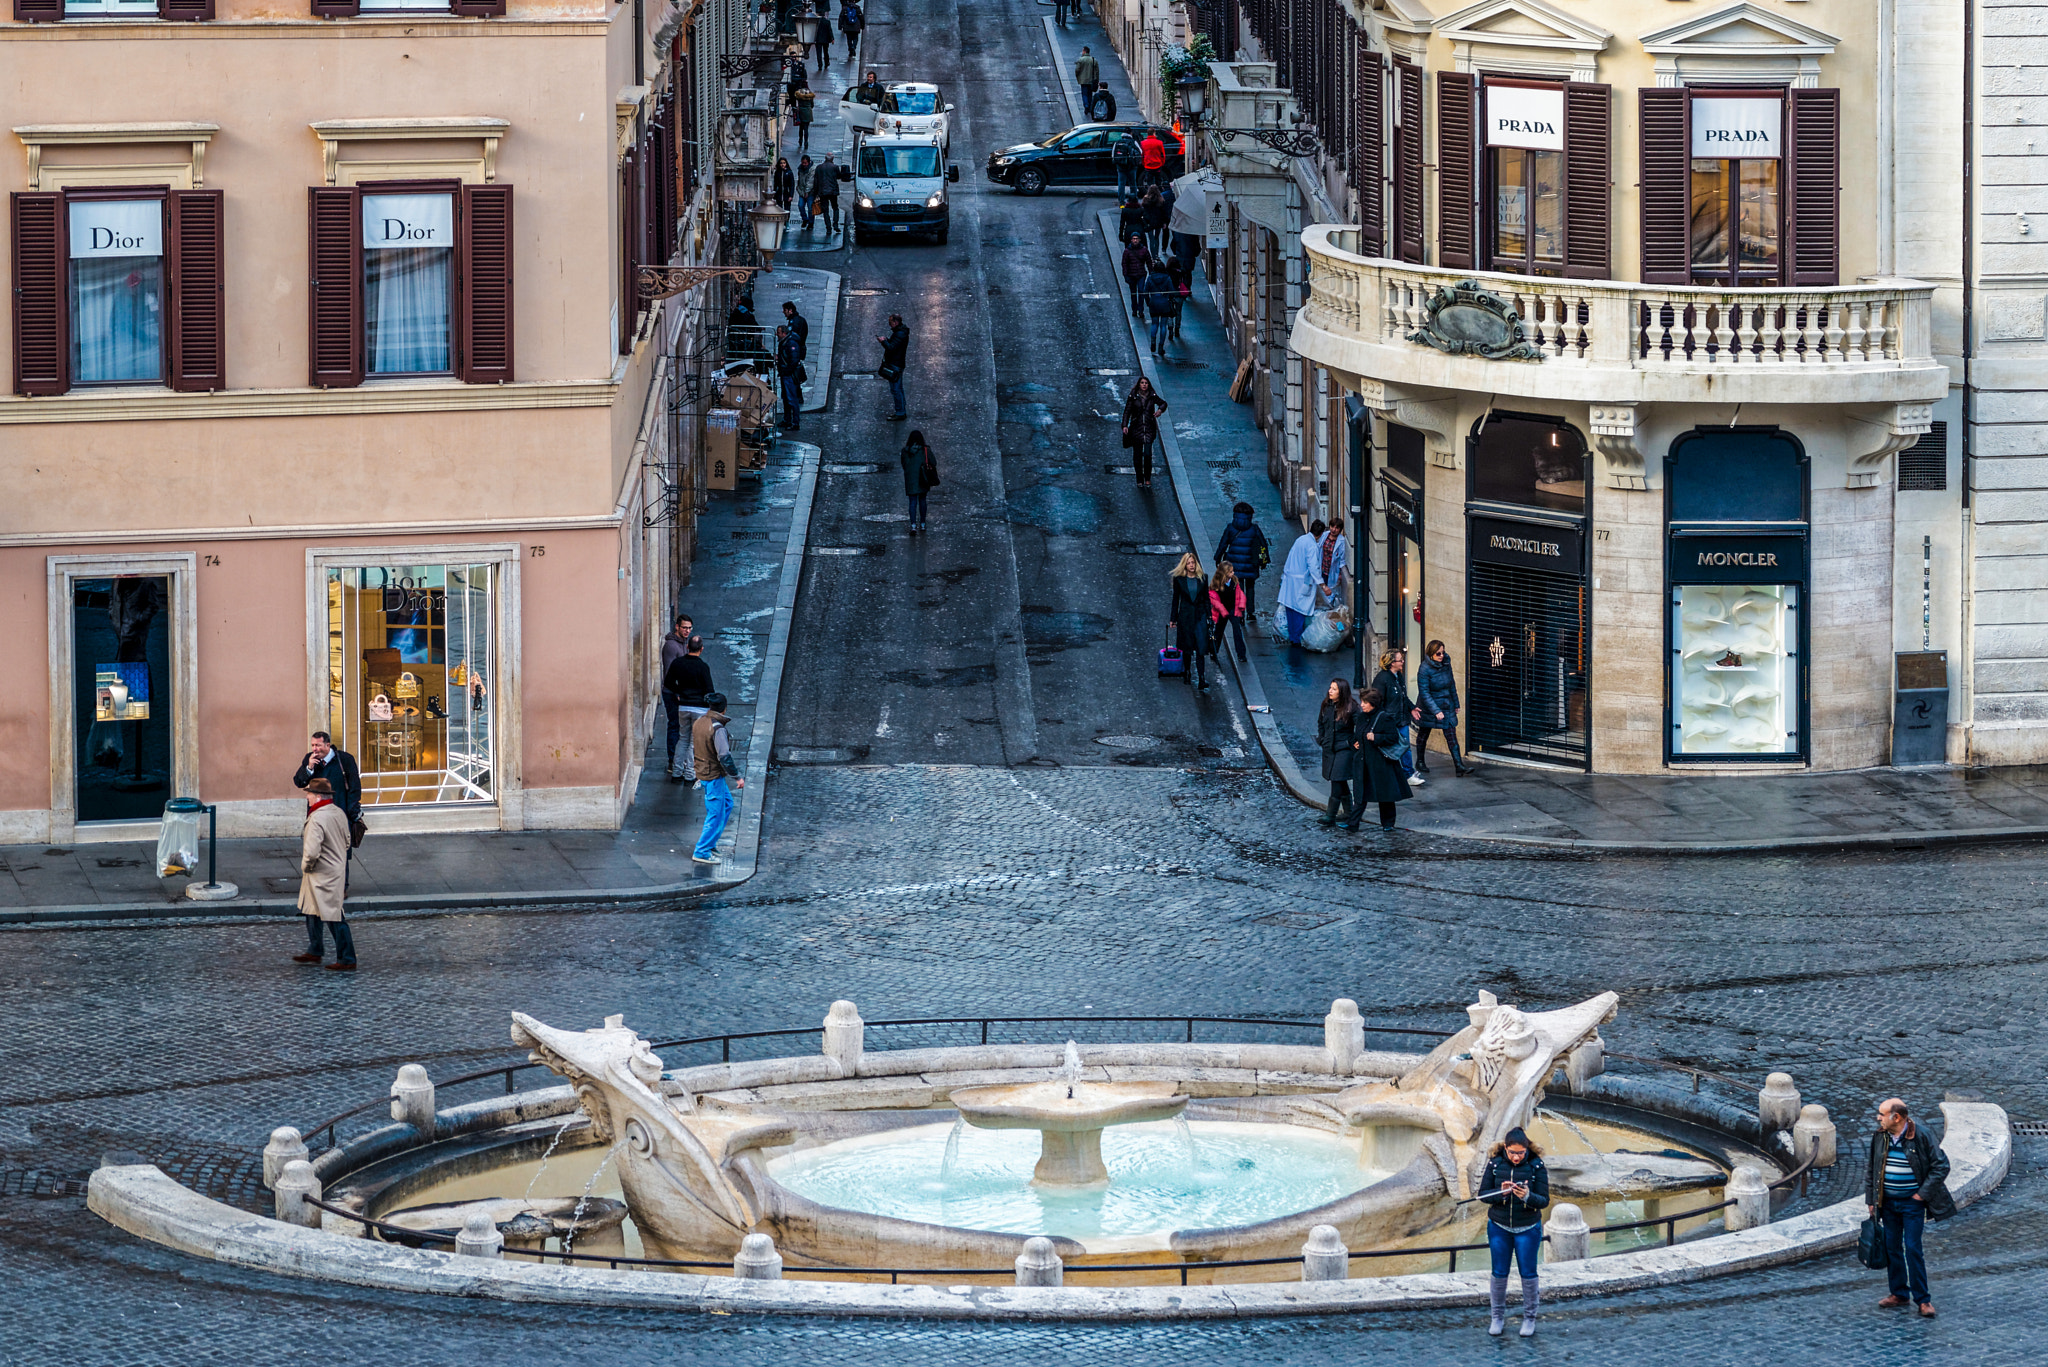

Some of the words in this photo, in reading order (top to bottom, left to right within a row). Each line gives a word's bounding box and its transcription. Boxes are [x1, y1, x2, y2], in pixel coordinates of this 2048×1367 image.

[1499, 119, 1555, 134] PRADA
[1706, 130, 1769, 141] PRADA
[381, 218, 435, 240] Dior
[1210, 219, 1225, 227] 250
[89, 227, 144, 249] Dior
[1596, 530, 1609, 540] 77
[530, 546, 545, 557] 75
[1490, 535, 1560, 556] MONCLER
[205, 555, 220, 566] 74
[1698, 552, 1778, 566] MONCLER
[376, 583, 448, 612] Dior
